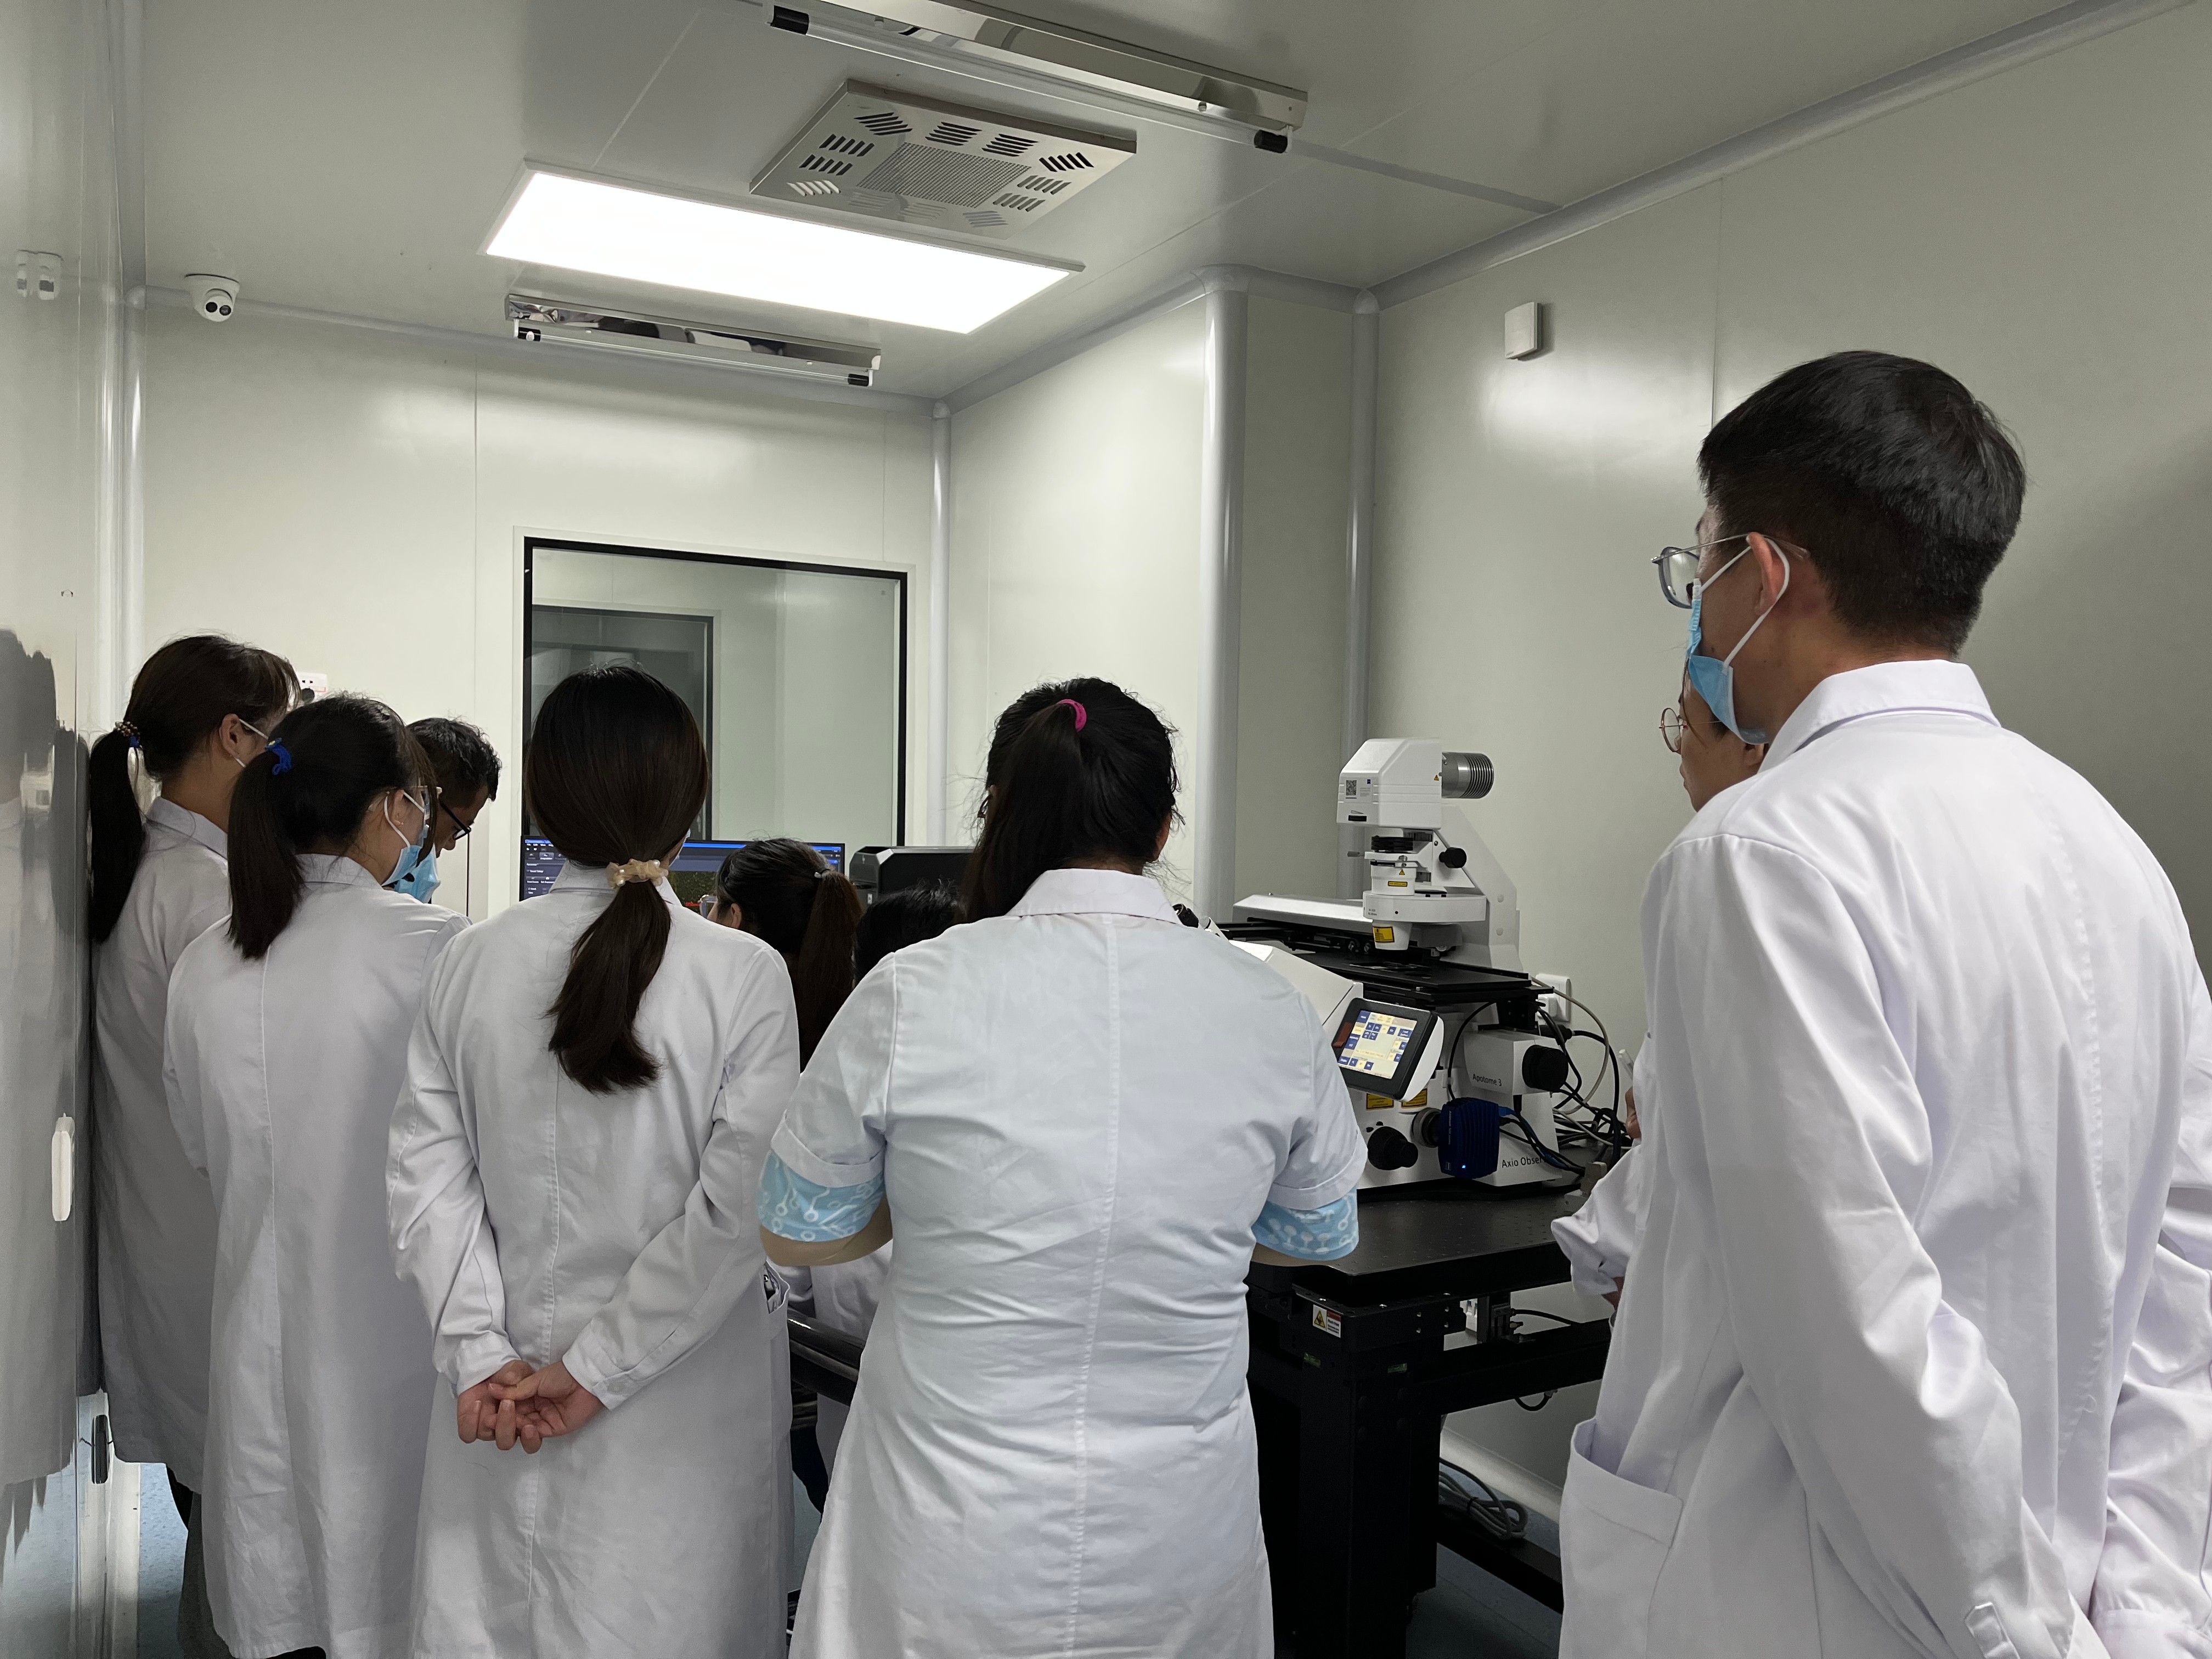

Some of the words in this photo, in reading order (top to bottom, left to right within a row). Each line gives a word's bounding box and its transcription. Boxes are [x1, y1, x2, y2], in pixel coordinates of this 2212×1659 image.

[1472, 1073, 1497, 1086] Apotome
[1498, 1079, 1502, 1087] 3
[1502, 1158, 1519, 1169] Axio
[1520, 1156, 1543, 1166] Obser
